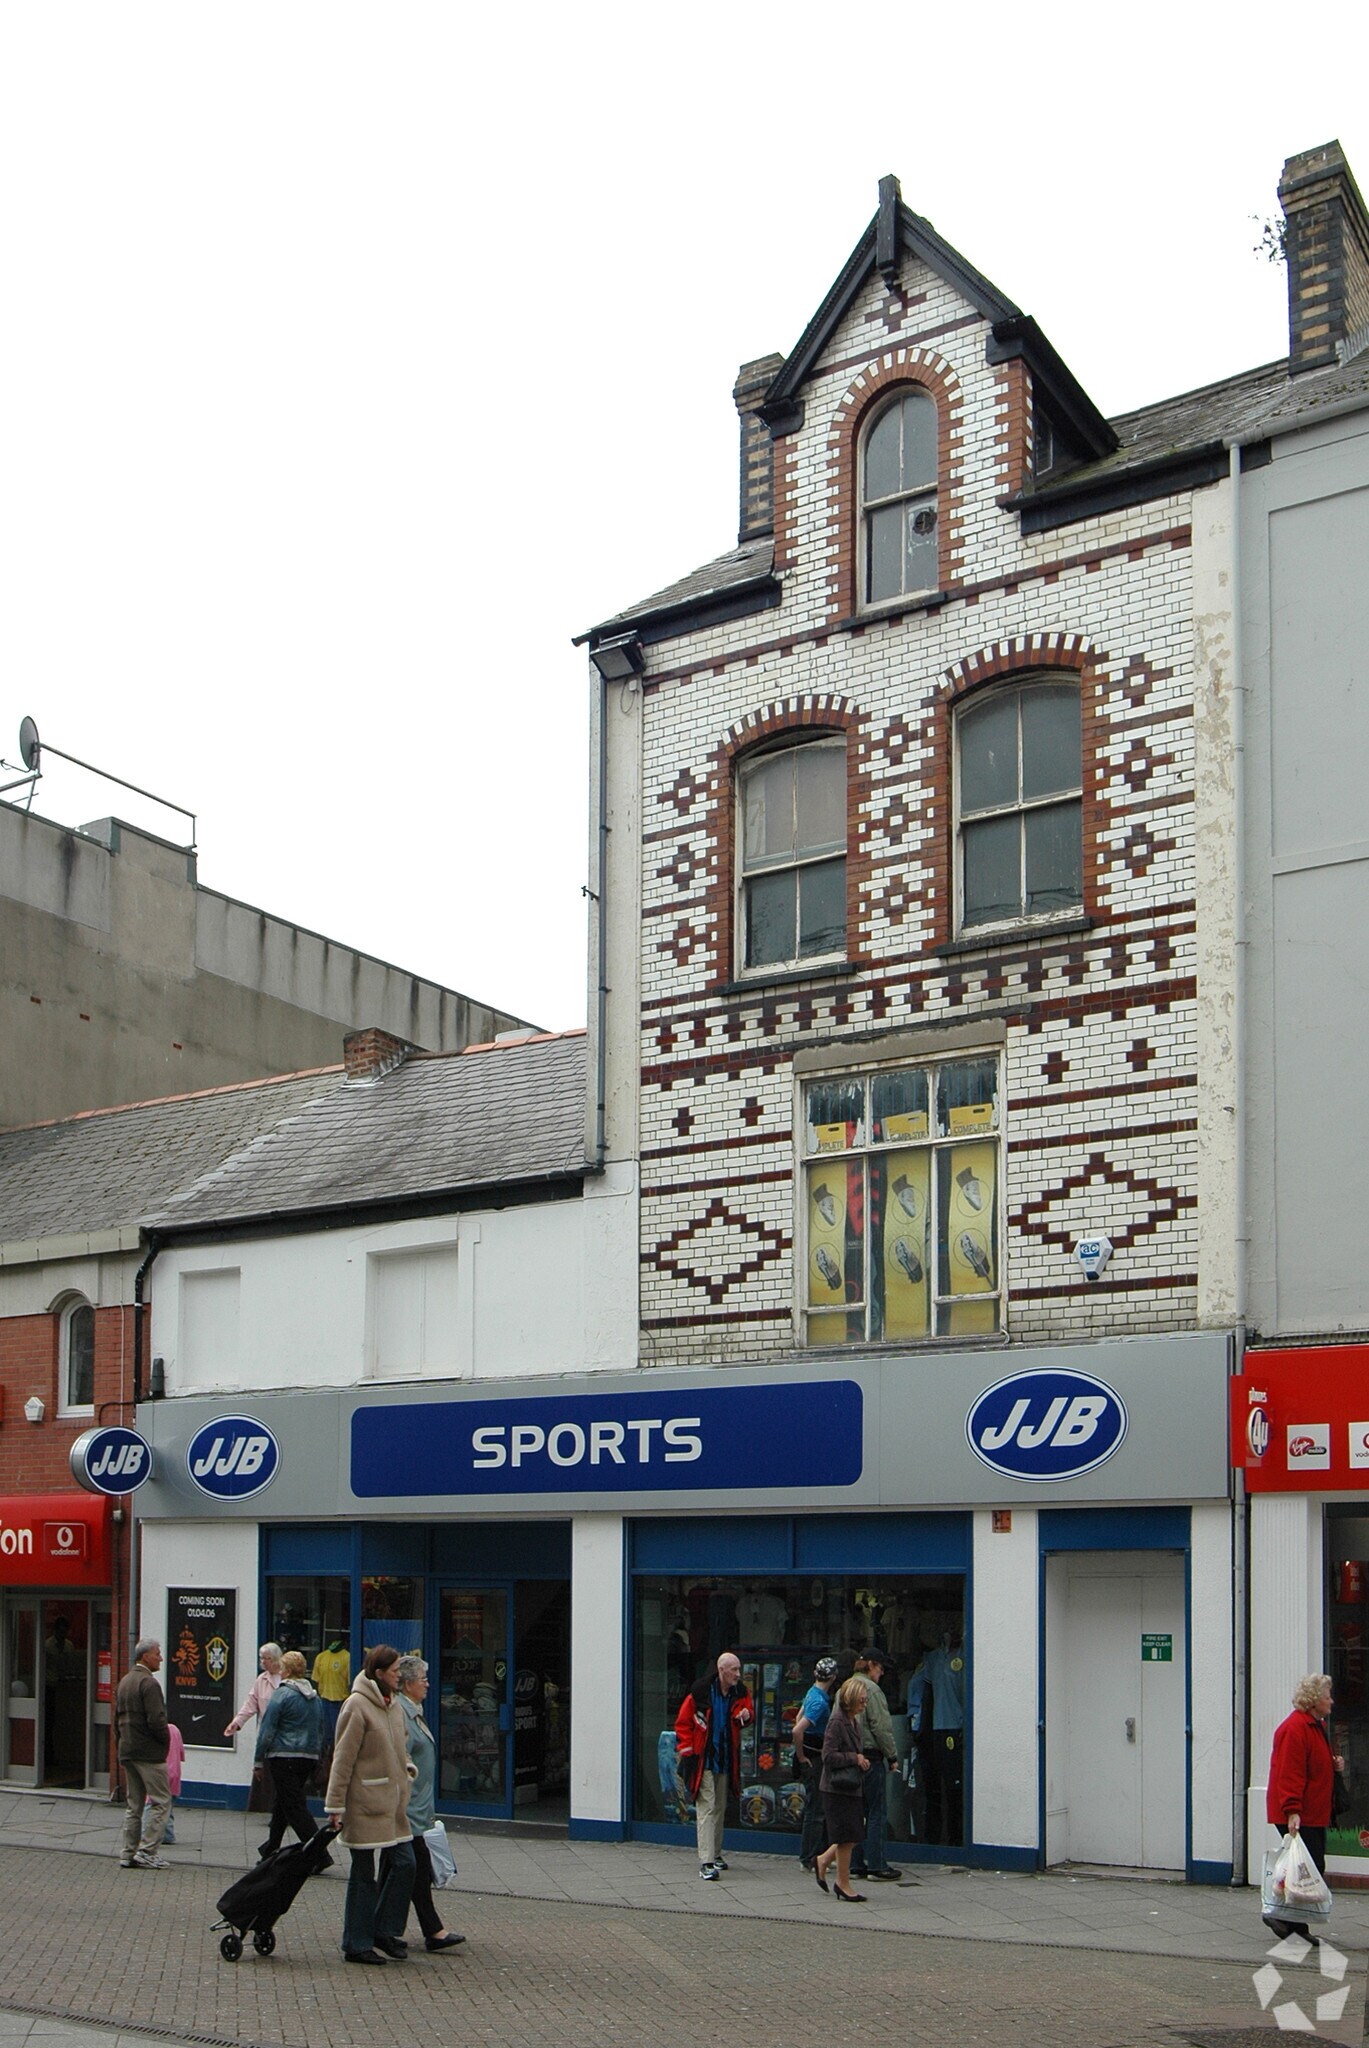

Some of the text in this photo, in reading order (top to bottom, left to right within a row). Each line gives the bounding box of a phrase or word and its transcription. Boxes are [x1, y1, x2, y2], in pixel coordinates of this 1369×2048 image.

[979, 1395, 1108, 1450] JJB
[471, 1417, 703, 1469] SPORTS
[91, 1444, 145, 1476] JJB
[193, 1436, 270, 1477] JJB
[49, 1547, 81, 1557] vodafone
[178, 1595, 225, 1606] COMING SOON
[187, 1608, 216, 1618] 01.04.06
[175, 1675, 197, 1687] KNVB
